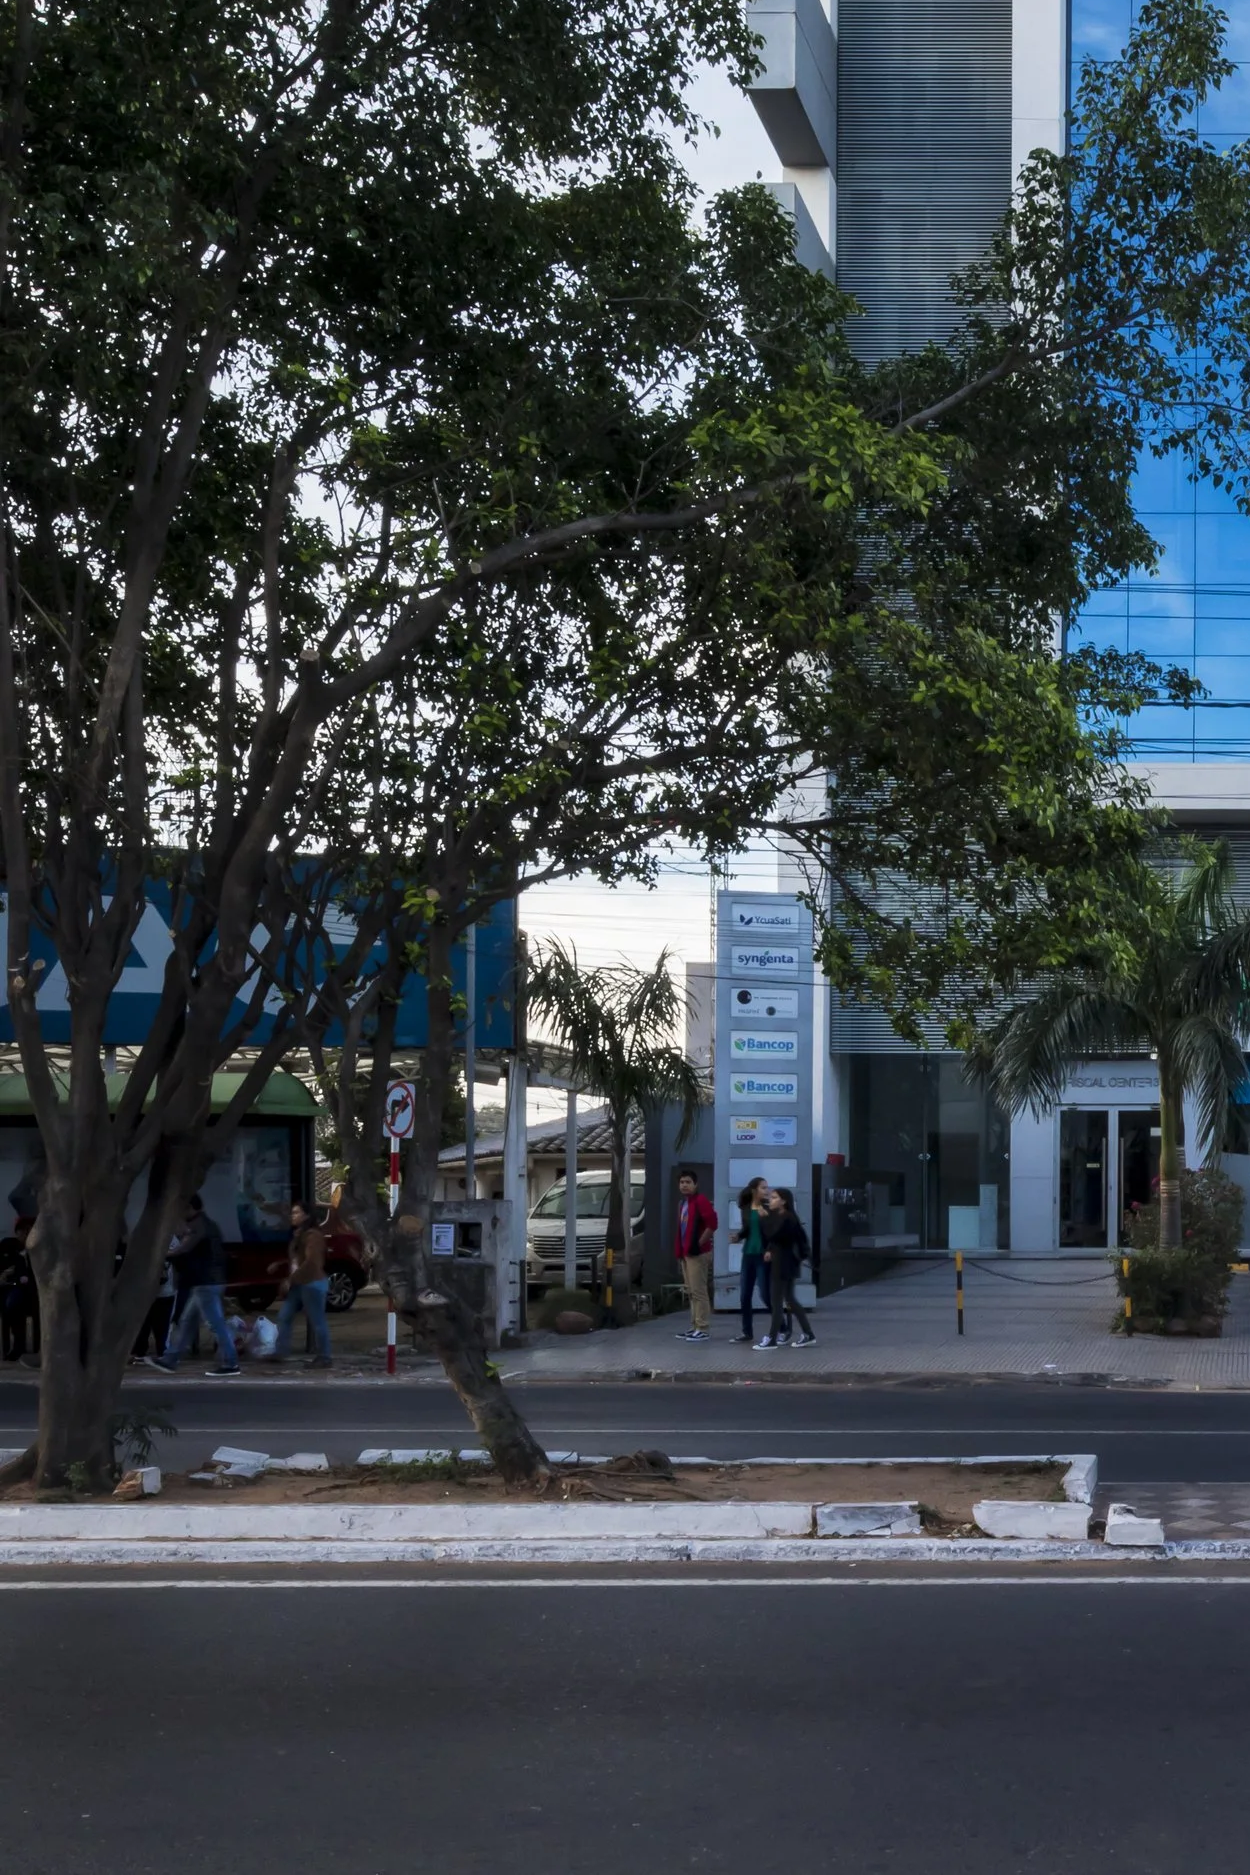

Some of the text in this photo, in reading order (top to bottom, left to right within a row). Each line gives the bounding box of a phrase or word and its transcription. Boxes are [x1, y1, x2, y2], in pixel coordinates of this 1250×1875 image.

[737, 953, 794, 966] syngenta
[747, 1037, 794, 1052] Bancop
[747, 1080, 794, 1094] Bancop
